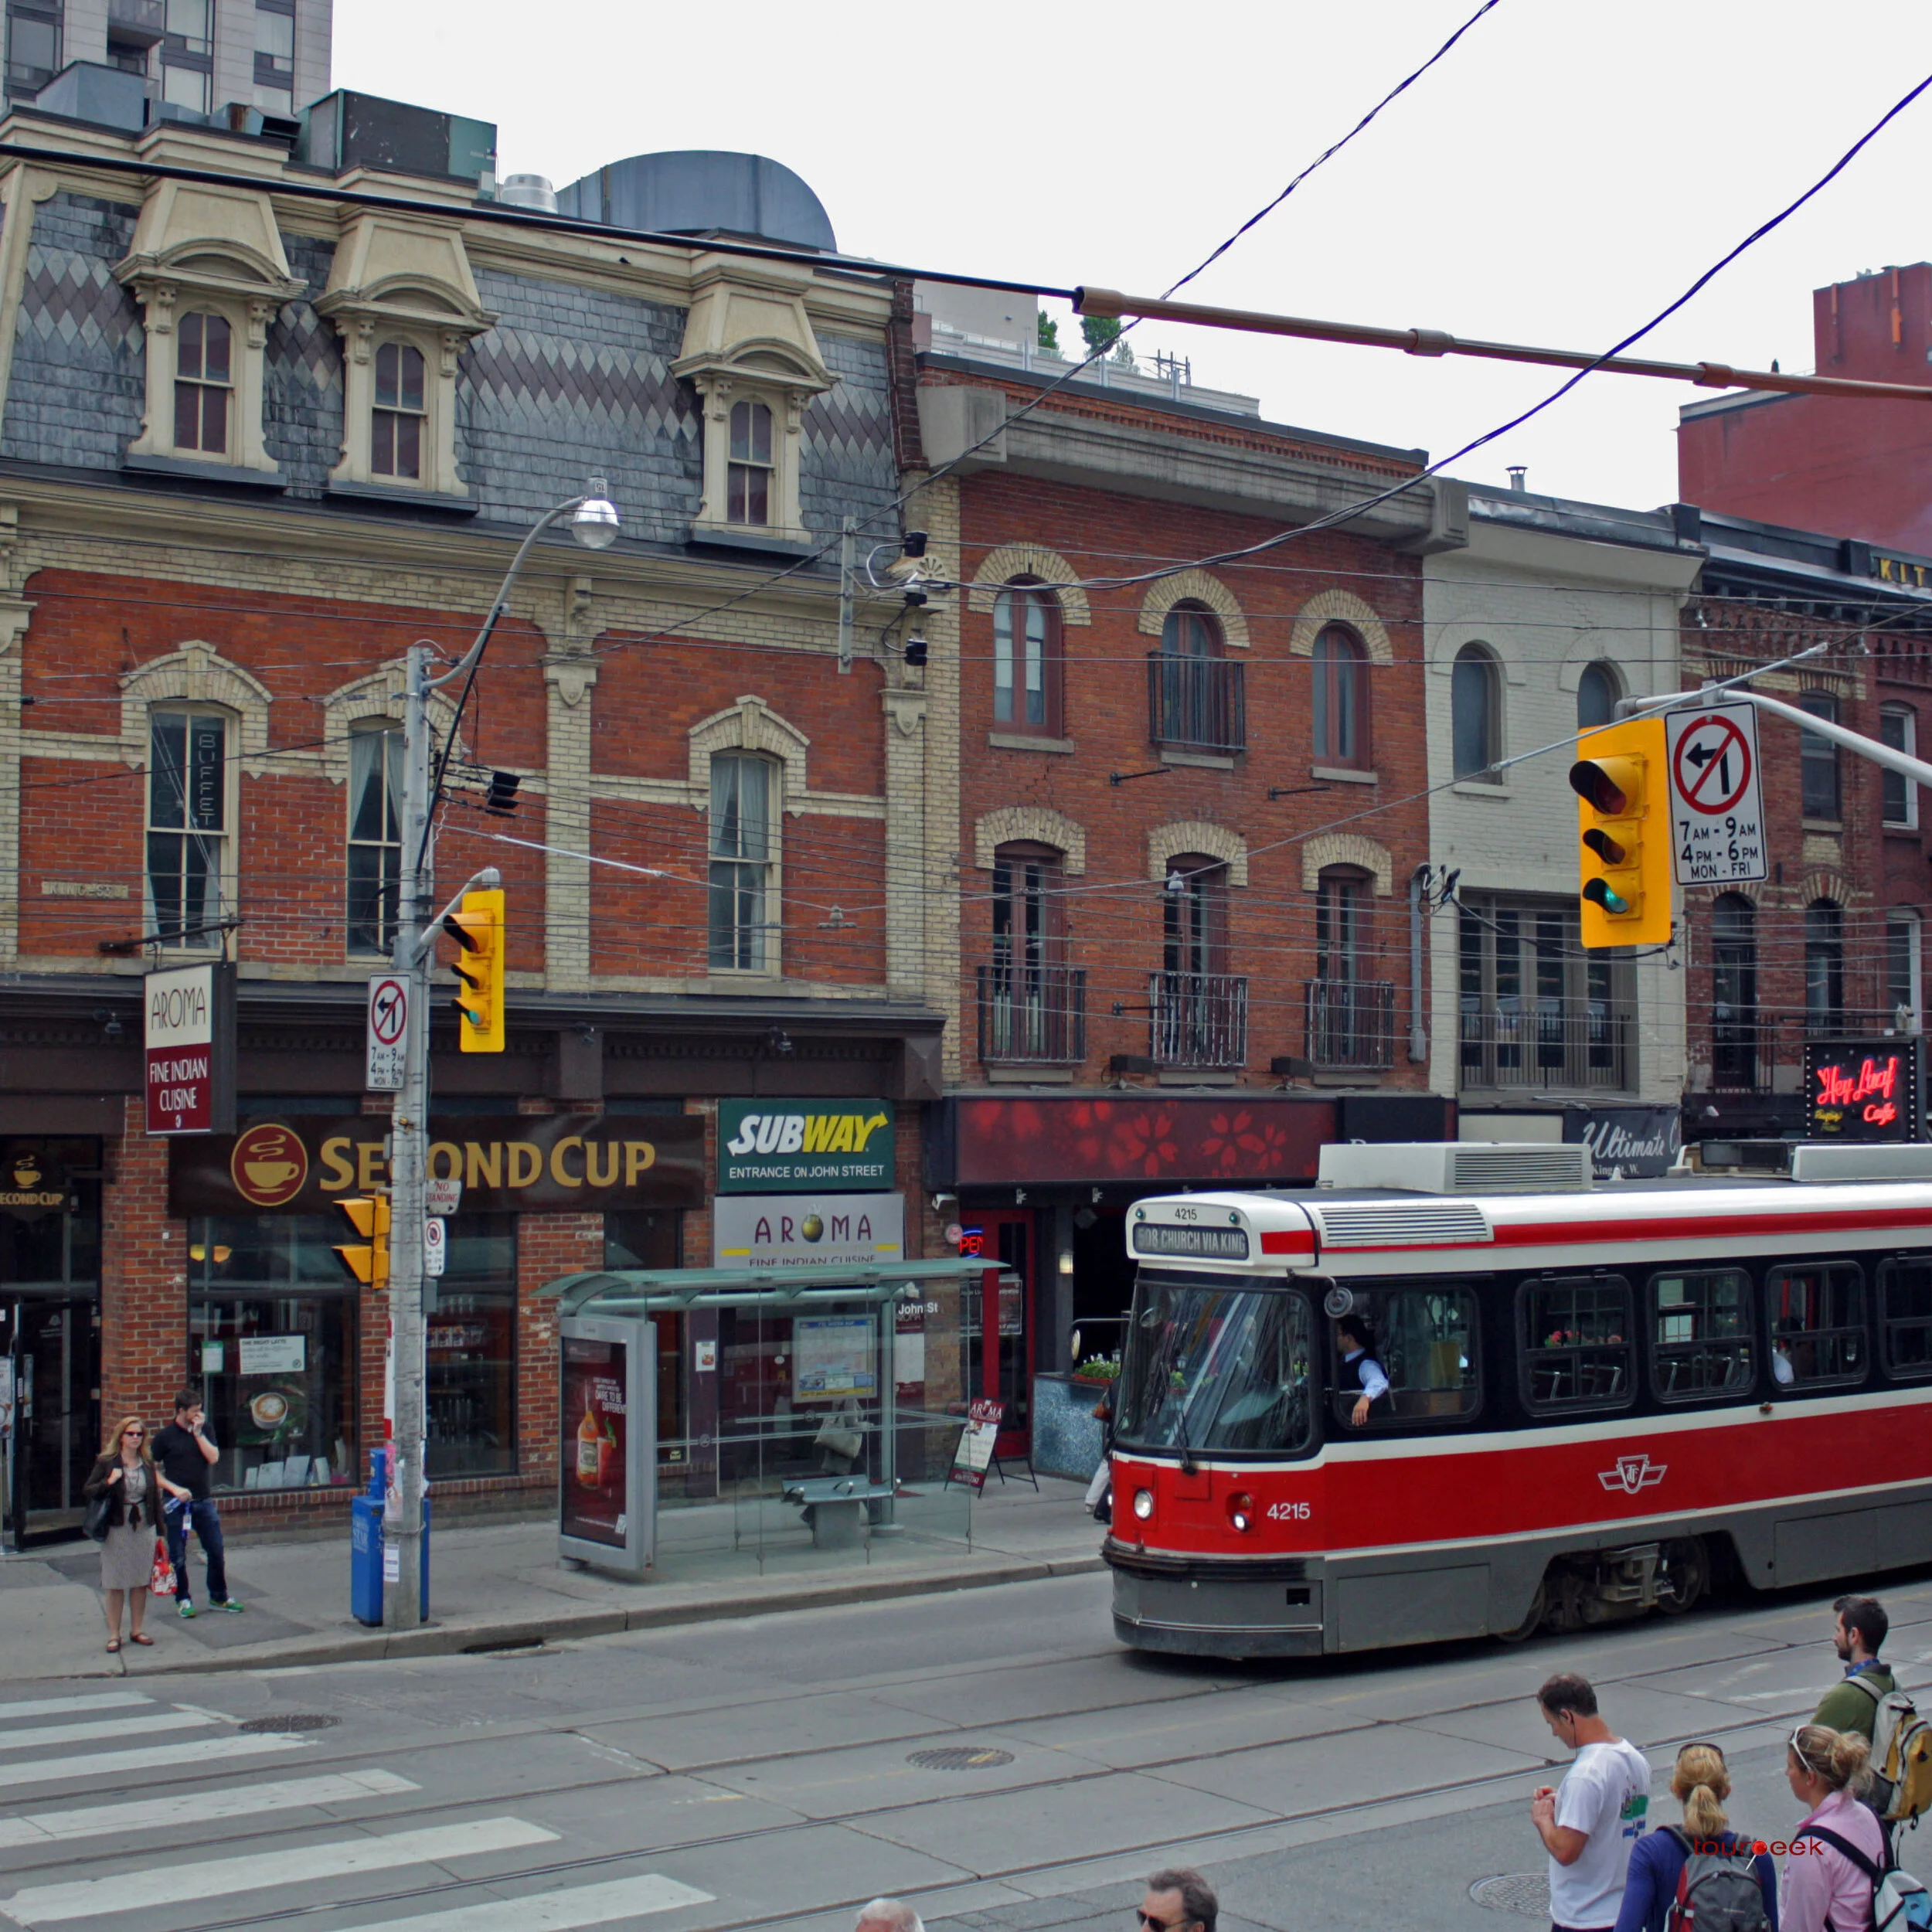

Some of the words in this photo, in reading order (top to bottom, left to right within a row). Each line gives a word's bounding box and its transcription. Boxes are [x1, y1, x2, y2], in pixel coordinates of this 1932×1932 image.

[1880, 559, 1926, 587] KIT
[199, 733, 216, 826] BUFFET
[1691, 866, 1717, 879] MON
[1731, 862, 1750, 876] FRI
[151, 986, 206, 1031] AROMA
[150, 1061, 169, 1083] FINE
[172, 1057, 207, 1082] INDIAN
[1817, 1065, 1855, 1105] Hey
[1852, 1058, 1899, 1101] Lucy
[160, 1087, 197, 1111] CUISINE
[727, 1111, 889, 1157] SUBWAY
[1583, 1121, 1665, 1158] Ultimate
[319, 1137, 543, 1191] SEOND
[549, 1136, 655, 1188] CUP
[730, 1166, 790, 1179] ENTRANCE
[794, 1167, 808, 1177] ON
[809, 1165, 838, 1177] JOHN
[842, 1165, 884, 1176] STREET
[1592, 1164, 1614, 1175] King
[436, 1182, 449, 1192] NO
[0, 1192, 38, 1206] ECOND
[1175, 1209, 1197, 1220] 4215
[1161, 1230, 1200, 1250] CHURCH
[1202, 1231, 1219, 1252] VIA
[1221, 1233, 1246, 1253] KING
[898, 1303, 923, 1315] John
[927, 1302, 939, 1313] St
[1267, 1502, 1311, 1520] 4215
